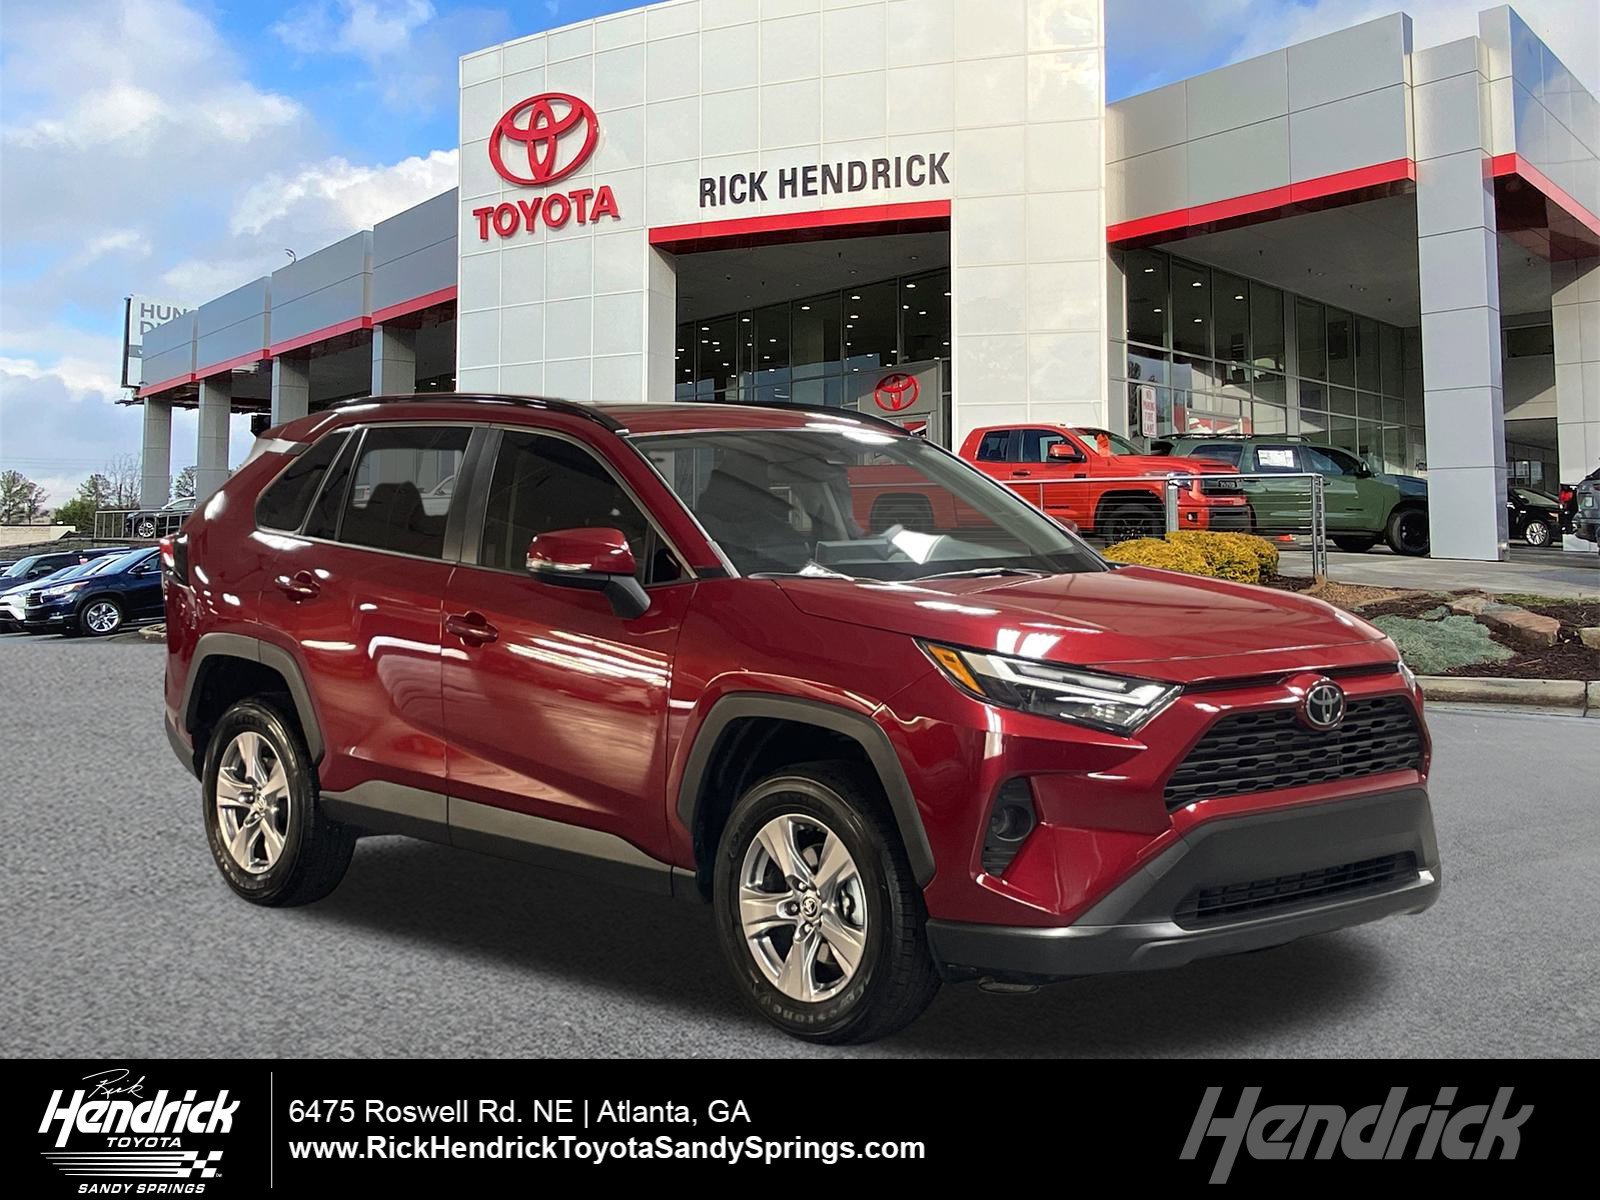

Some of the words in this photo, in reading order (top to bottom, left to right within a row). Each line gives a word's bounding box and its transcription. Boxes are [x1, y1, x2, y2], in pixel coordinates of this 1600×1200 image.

[699, 170, 768, 208] RICK
[778, 152, 950, 199] HENDRICK
[473, 185, 620, 240] TOYOTA
[140, 320, 161, 335] D
